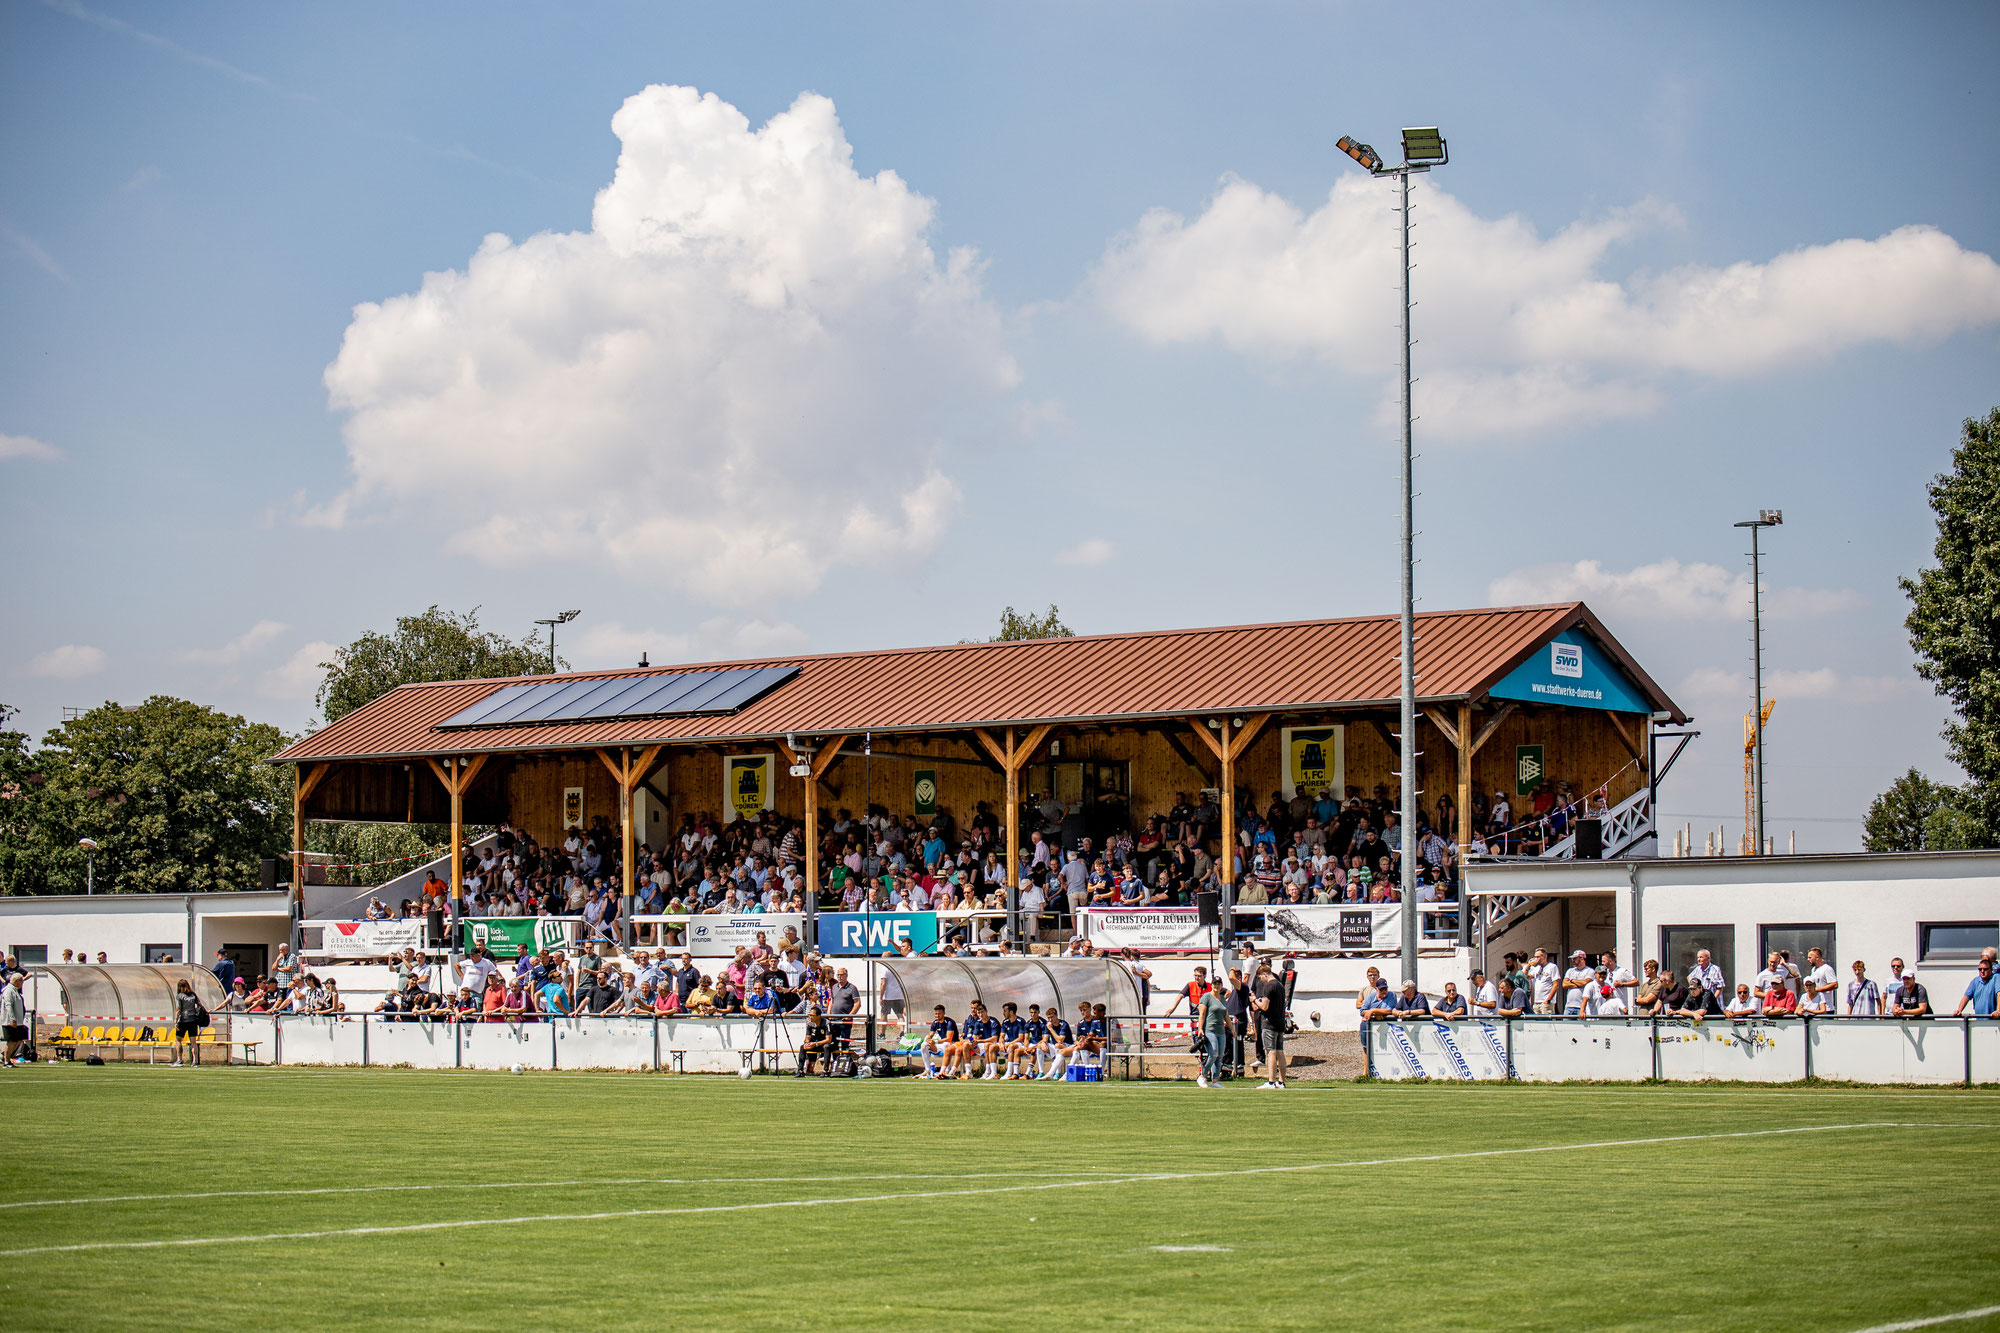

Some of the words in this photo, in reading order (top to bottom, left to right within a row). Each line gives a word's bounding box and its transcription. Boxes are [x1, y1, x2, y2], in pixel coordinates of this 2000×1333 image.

[1556, 656, 1578, 667] SWD
[1532, 683, 1602, 700] www.stadtwerke-dueren.de
[1312, 771, 1323, 779] FC
[748, 794, 757, 802] FC
[1105, 915, 1161, 924] CHRISTOPH
[1163, 913, 1199, 924] RÜHLM
[842, 919, 911, 947] RWE
[1386, 1022, 1426, 1078] ALUCOBES
